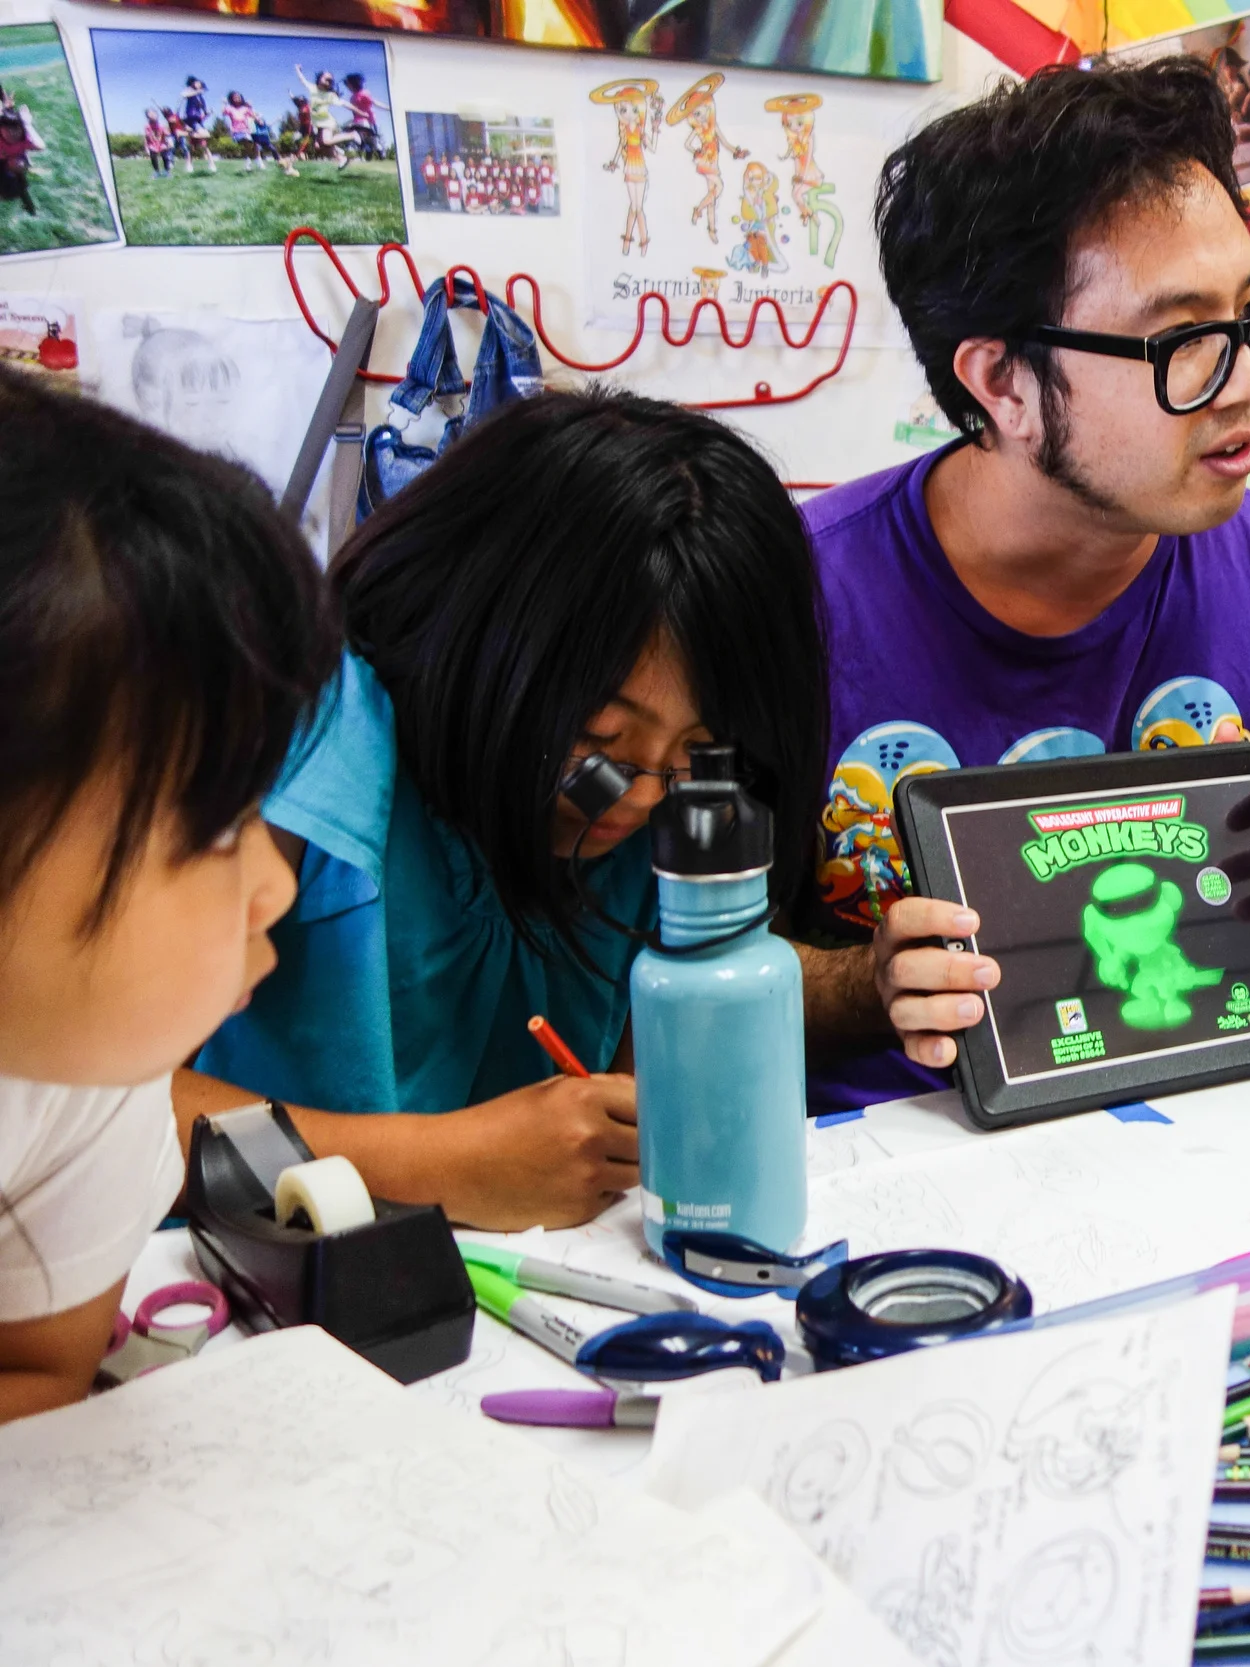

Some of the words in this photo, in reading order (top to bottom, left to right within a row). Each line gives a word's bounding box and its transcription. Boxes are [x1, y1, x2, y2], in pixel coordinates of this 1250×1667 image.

[1094, 805, 1150, 822] HYPERACTIVE
[1151, 801, 1179, 816] NINJA
[1024, 821, 1206, 878] MONKEYS
[1051, 1030, 1103, 1049] EXCLUSIVE
